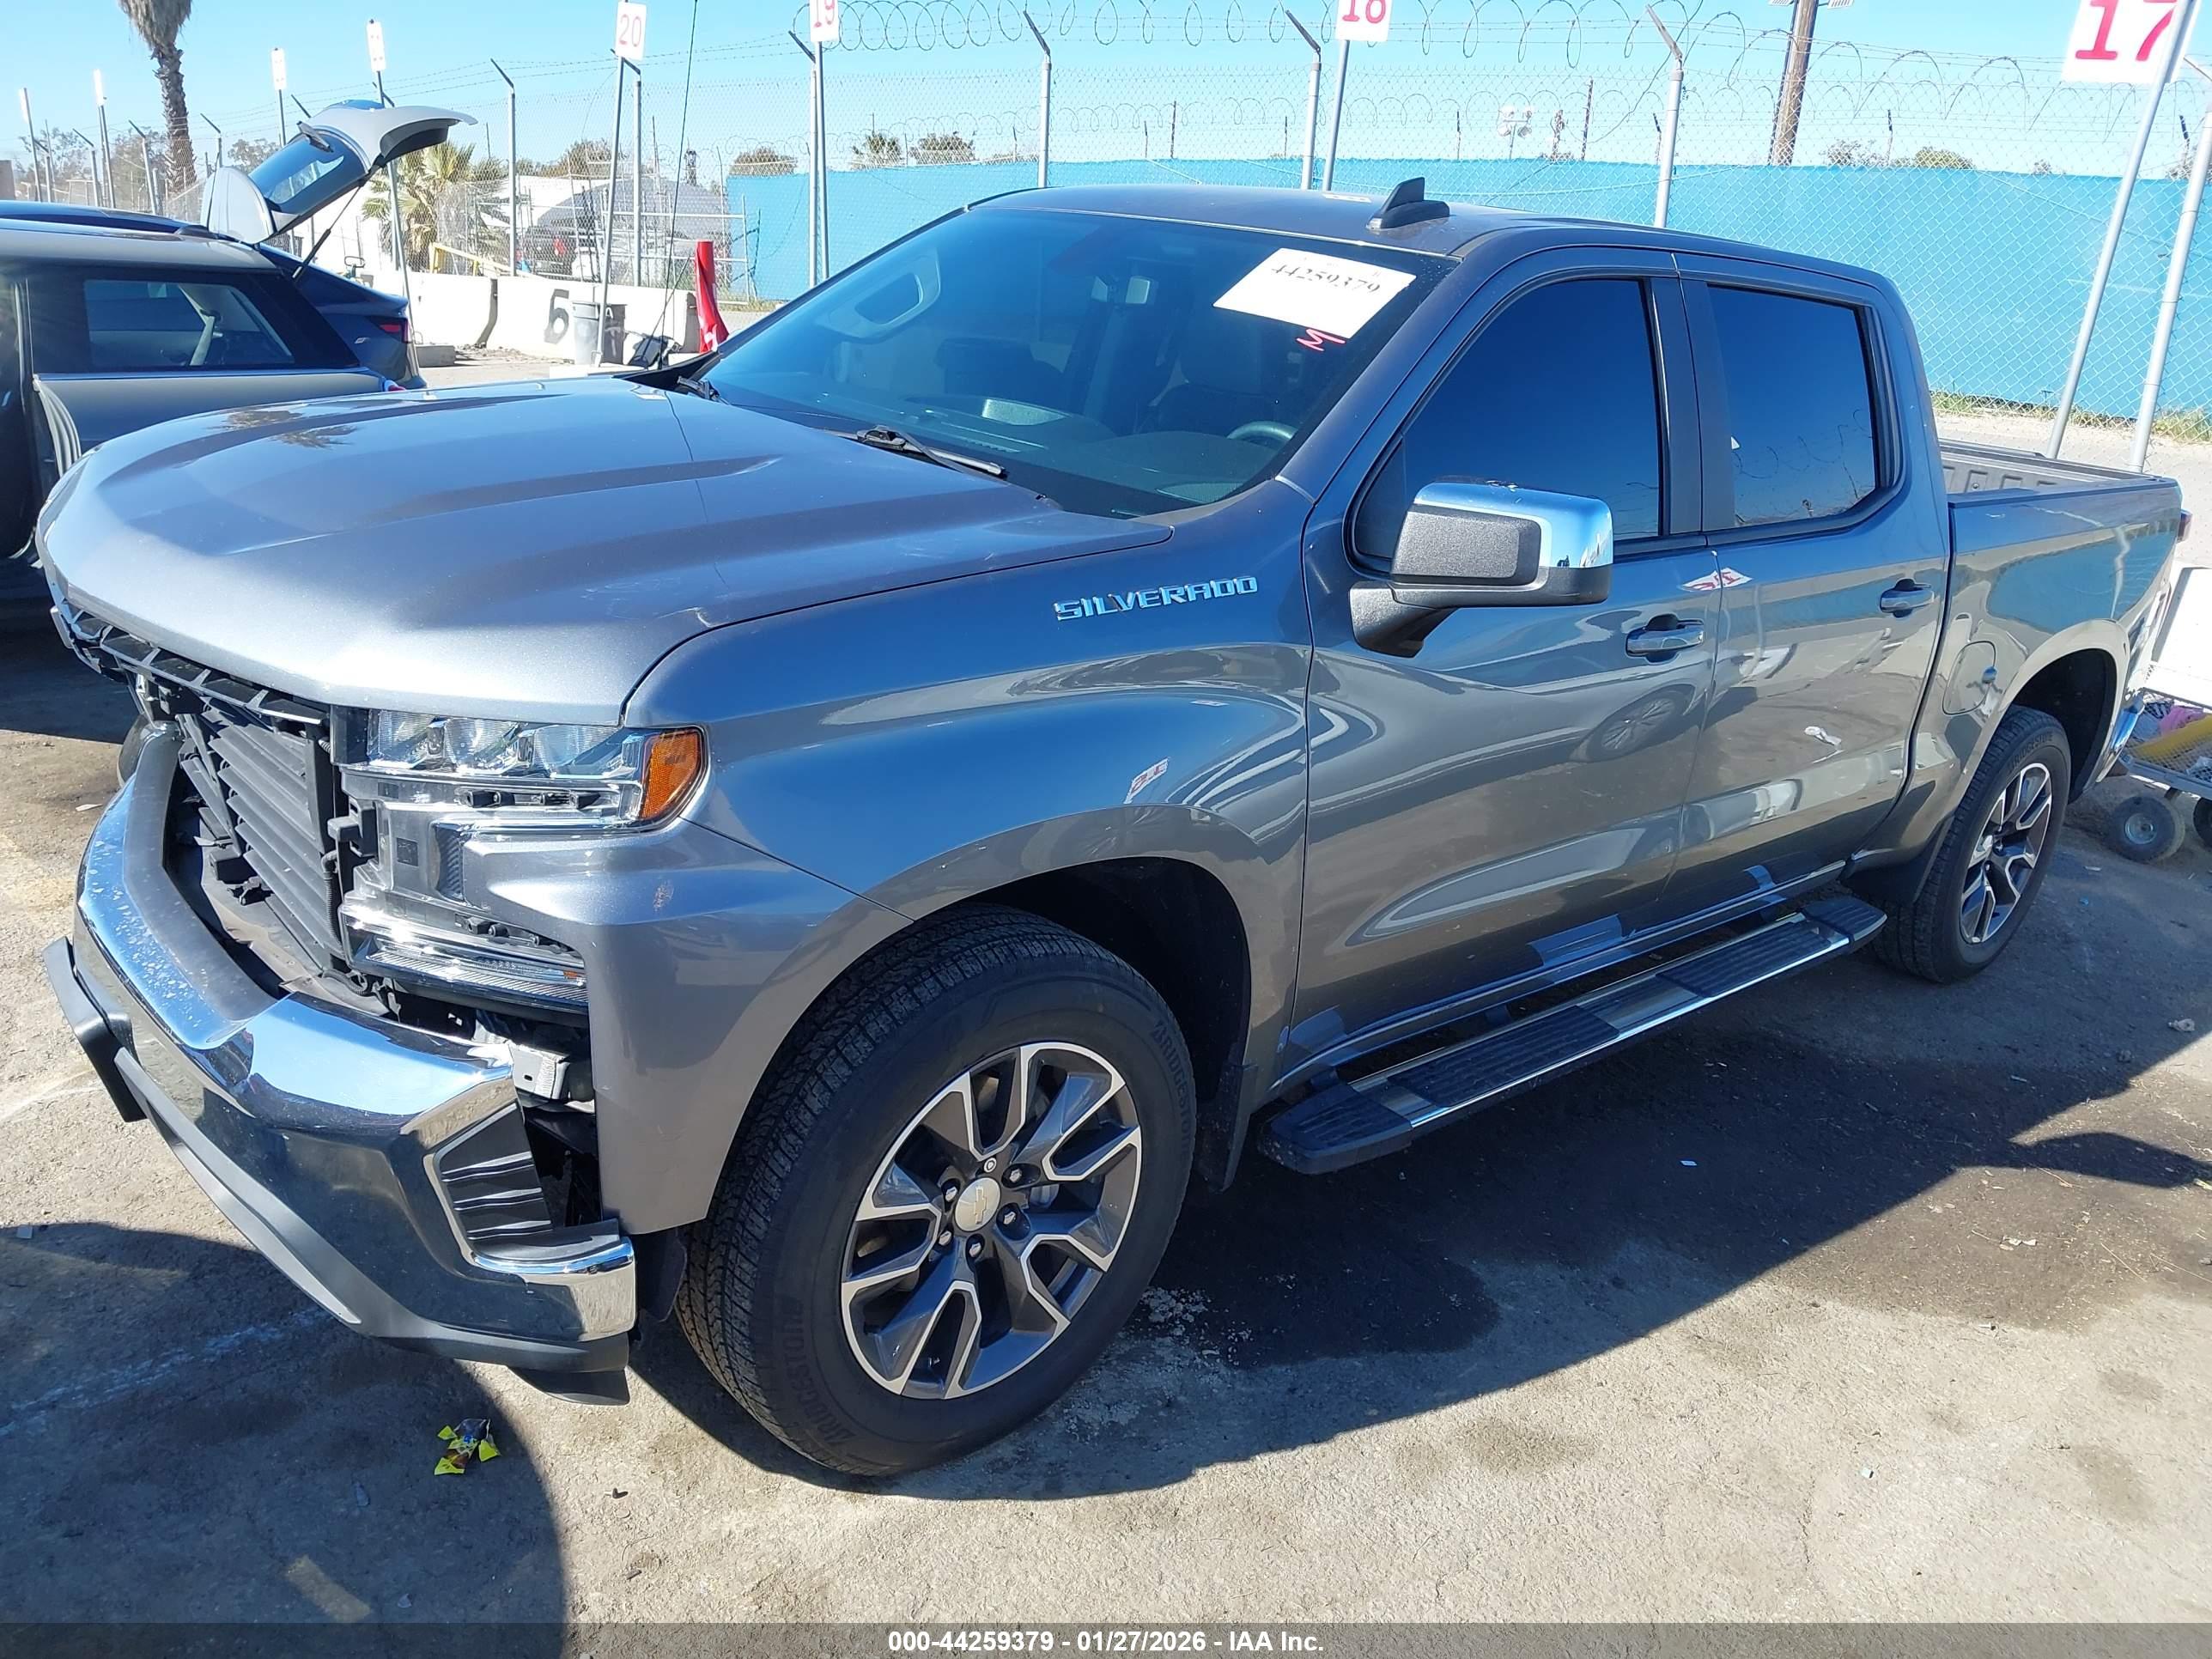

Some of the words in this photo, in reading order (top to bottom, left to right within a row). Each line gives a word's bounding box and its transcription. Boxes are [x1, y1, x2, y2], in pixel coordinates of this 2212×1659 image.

[619, 14, 642, 47] 20
[2075, 0, 2178, 61] 17
[1053, 575, 1259, 621] SILVERADO
